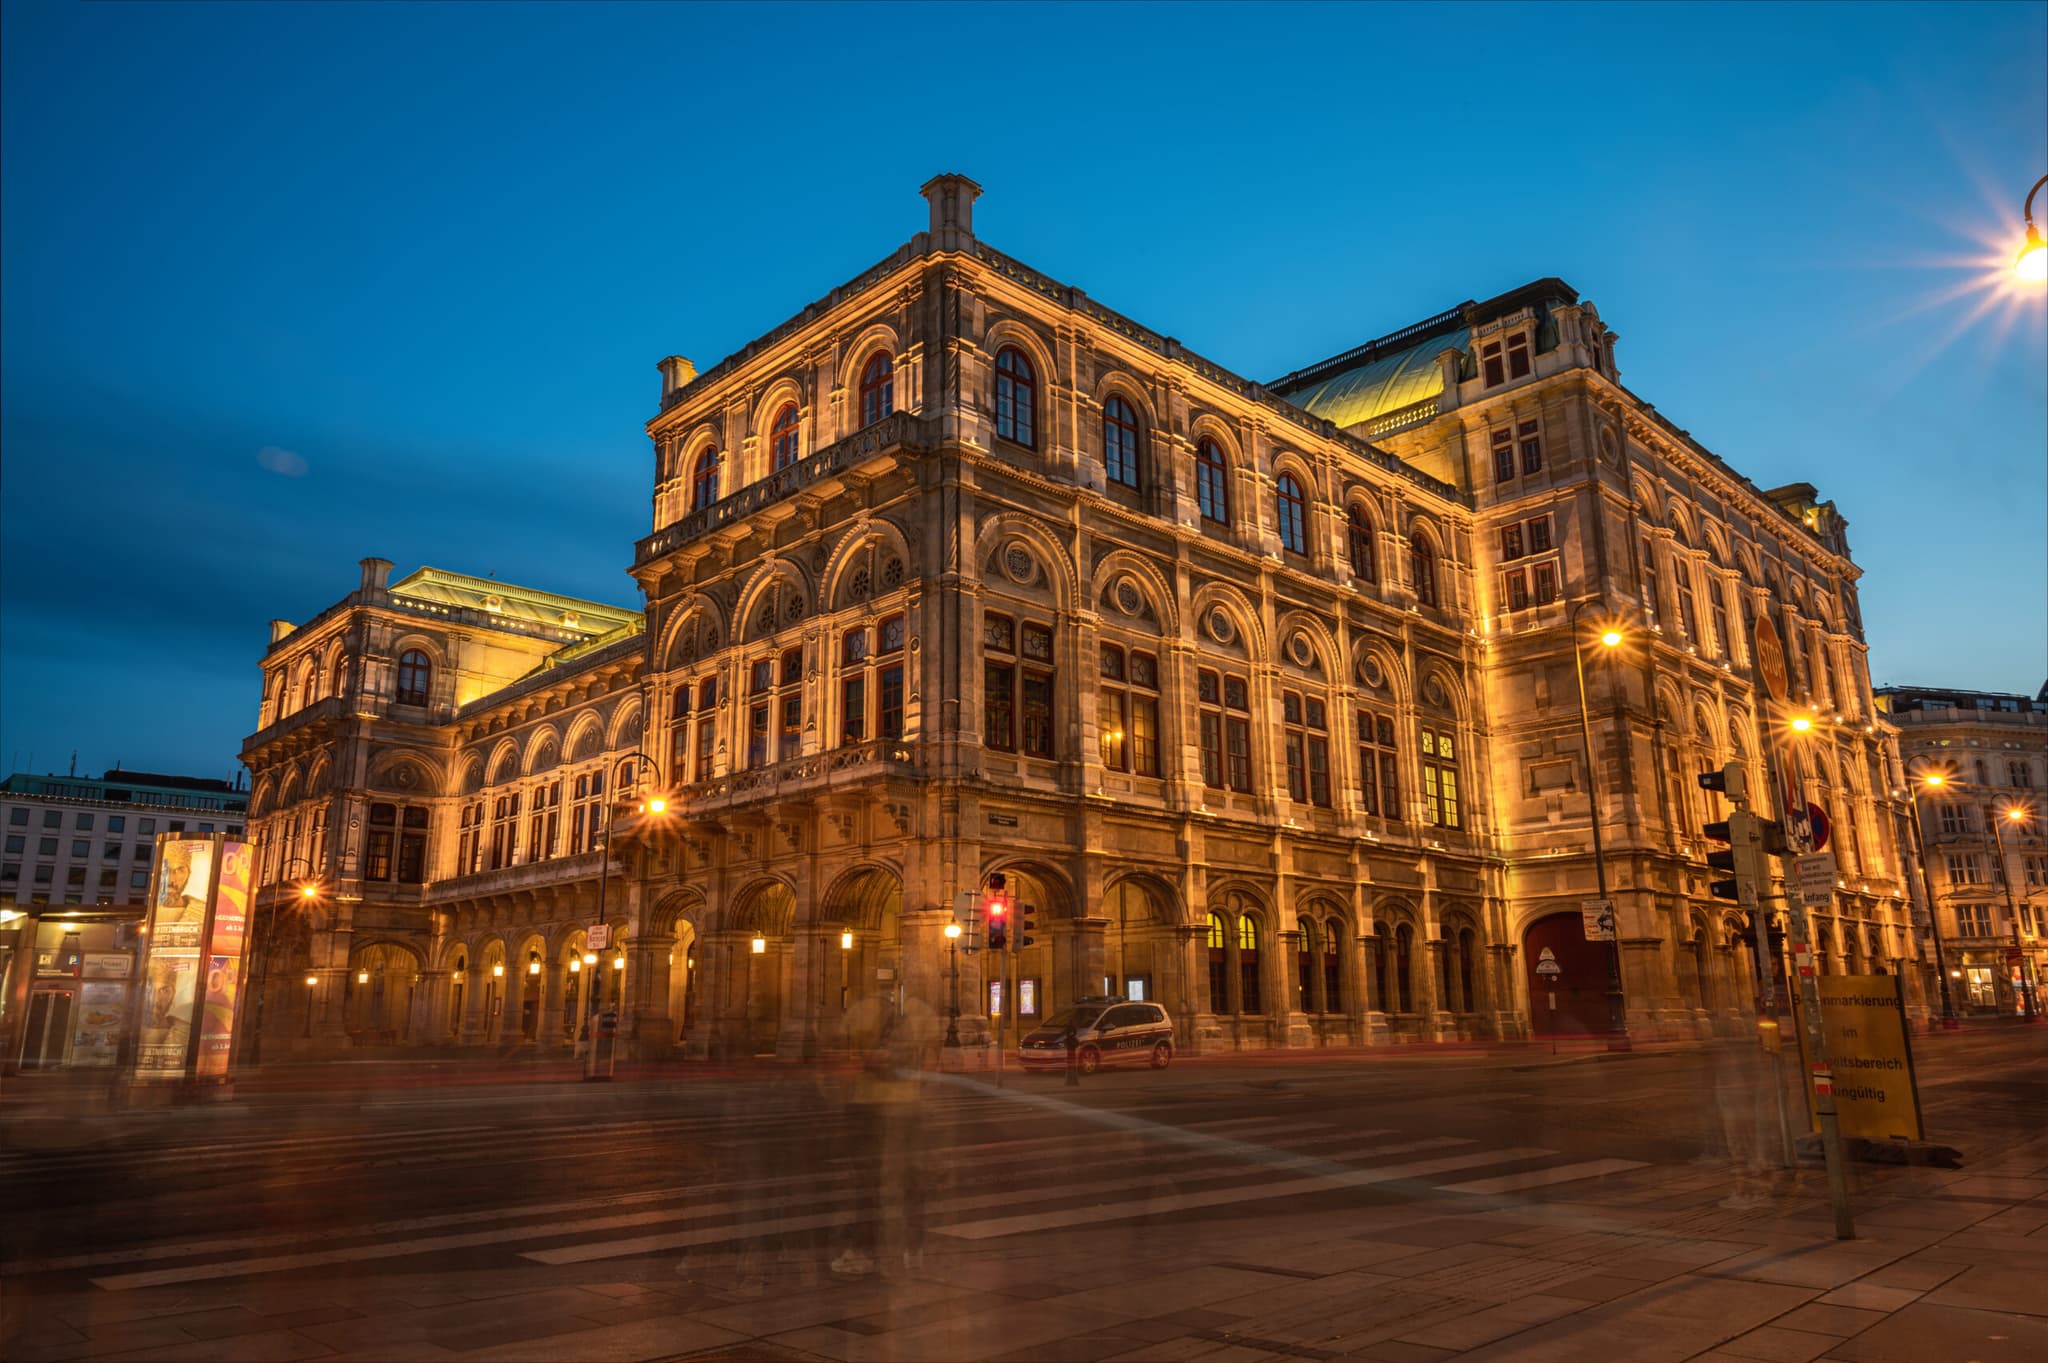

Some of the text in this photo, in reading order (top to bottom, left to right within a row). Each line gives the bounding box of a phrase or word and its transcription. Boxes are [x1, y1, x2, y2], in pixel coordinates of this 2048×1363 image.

[1760, 638, 1783, 679] STOP
[1804, 892, 1830, 903] Anfang
[1792, 993, 1901, 1010] Bnmarkierung
[1843, 1025, 1858, 1039] im
[1116, 1038, 1143, 1049] POLIZEI
[1833, 1085, 1886, 1103] ungültig
